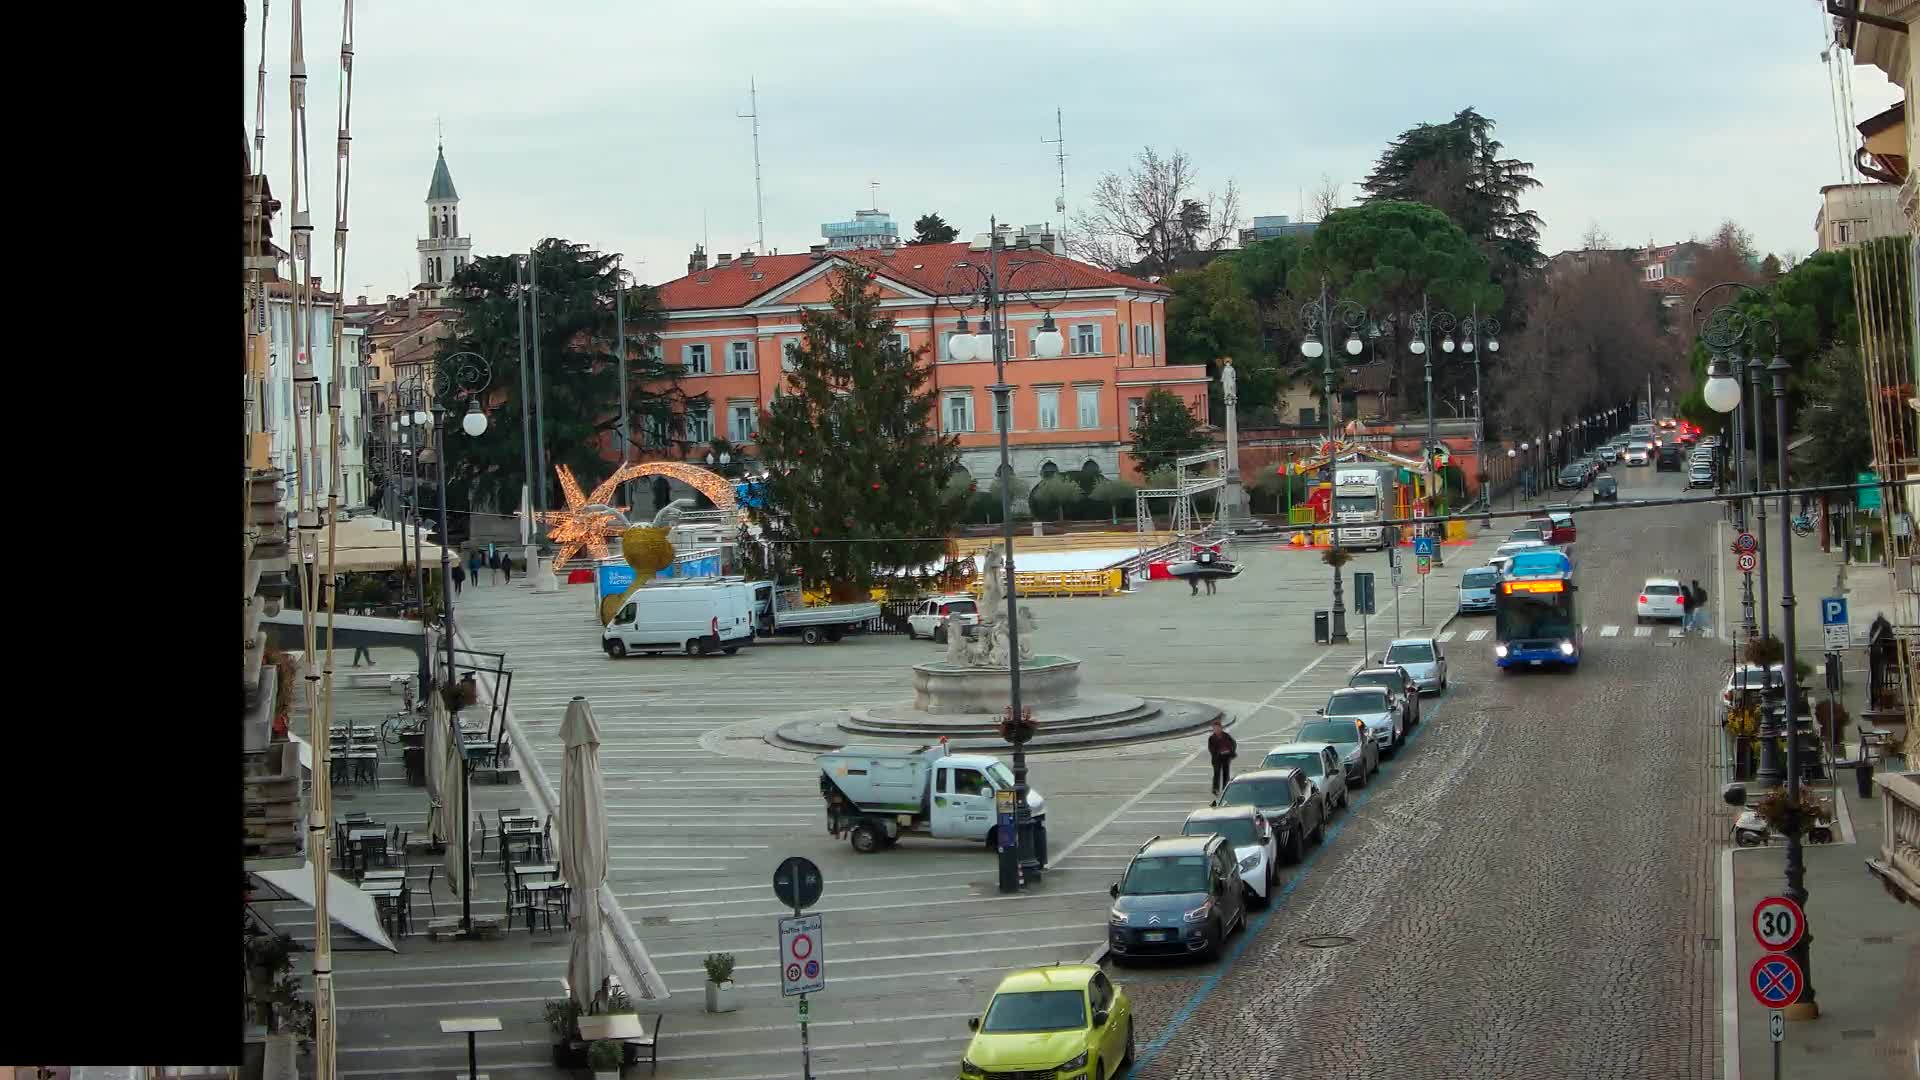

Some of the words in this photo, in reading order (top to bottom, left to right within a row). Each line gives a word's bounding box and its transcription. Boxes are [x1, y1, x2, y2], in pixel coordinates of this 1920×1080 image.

[1742, 558, 1752, 567] 20
[1827, 602, 1842, 622] P
[1762, 911, 1791, 938] 30
[790, 966, 799, 978] 20
